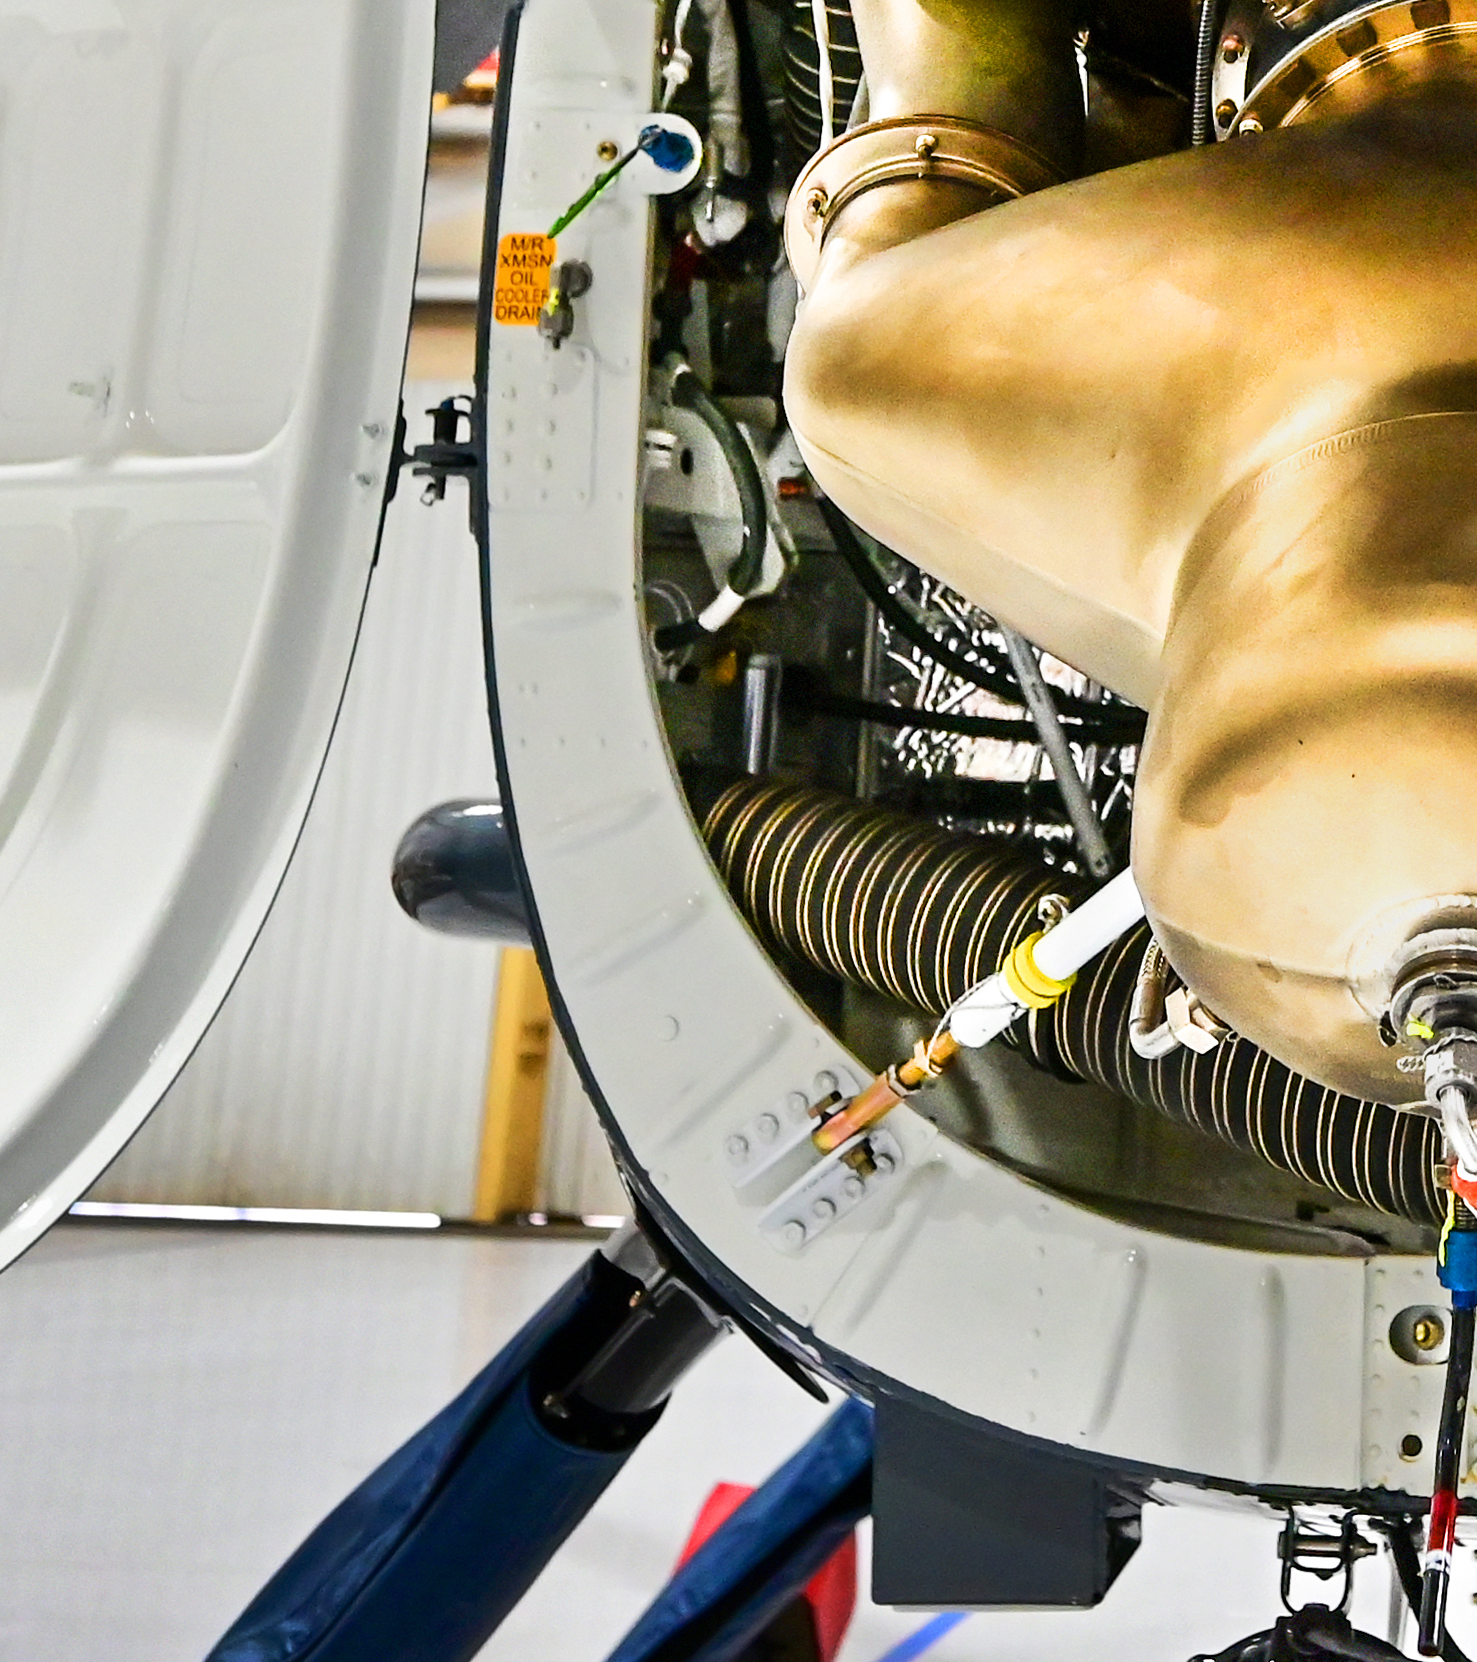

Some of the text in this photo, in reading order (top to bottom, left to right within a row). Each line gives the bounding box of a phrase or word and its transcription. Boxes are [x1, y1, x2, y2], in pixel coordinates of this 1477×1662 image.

[510, 236, 544, 252] M/R
[499, 253, 553, 269] XMSN
[510, 270, 538, 286] OIL
